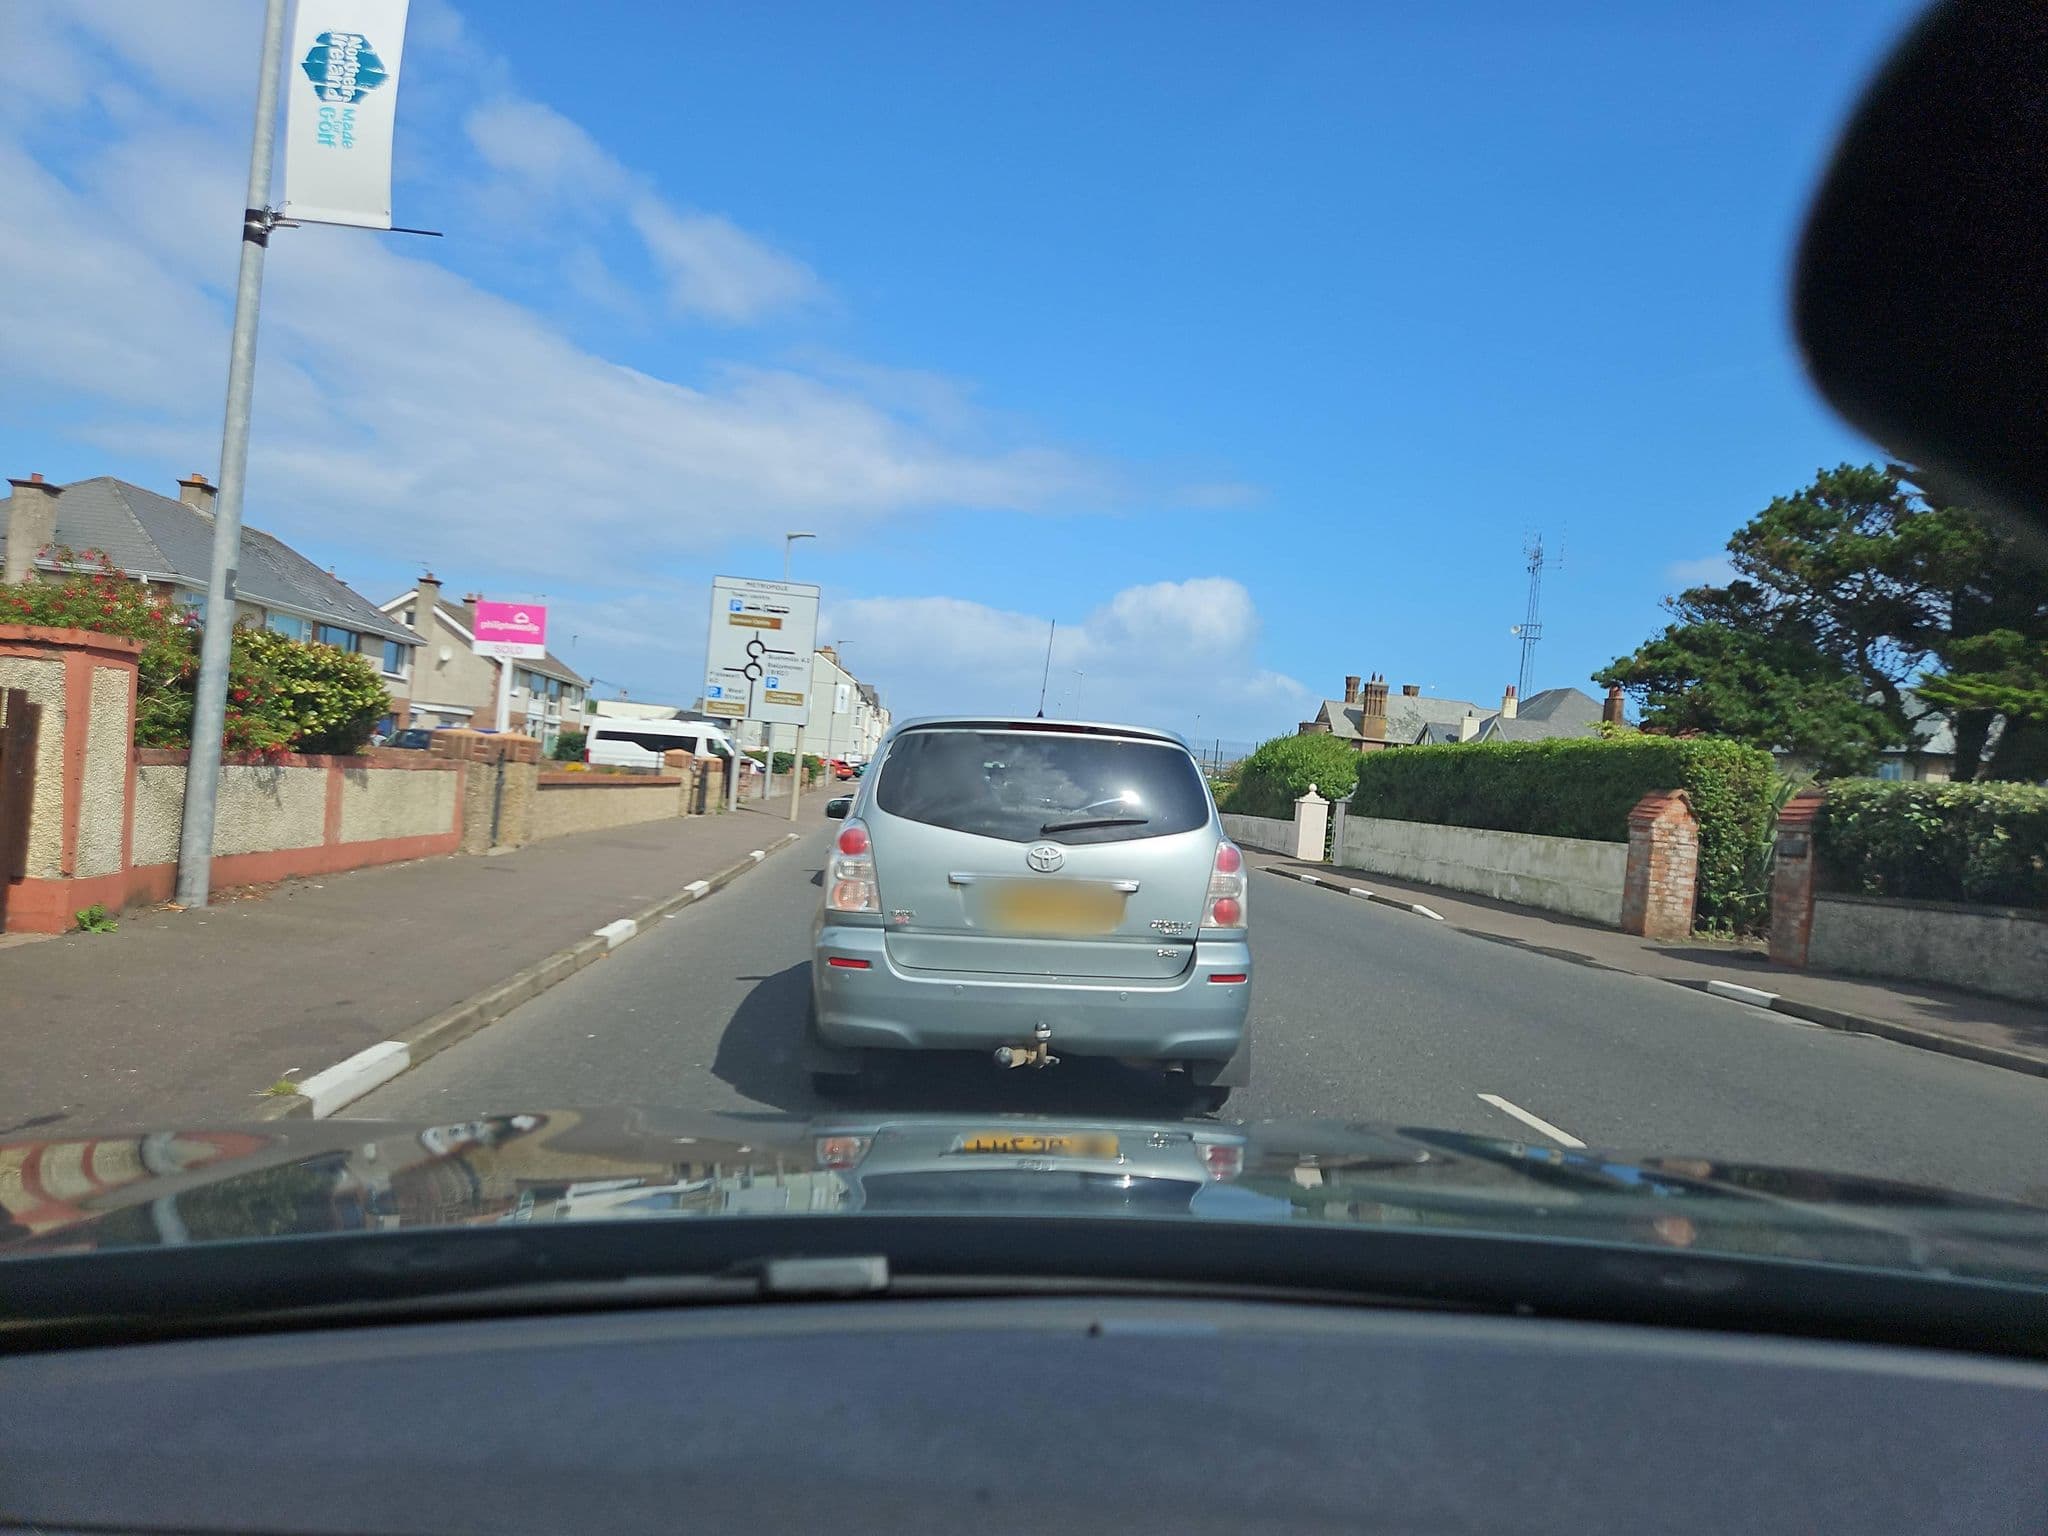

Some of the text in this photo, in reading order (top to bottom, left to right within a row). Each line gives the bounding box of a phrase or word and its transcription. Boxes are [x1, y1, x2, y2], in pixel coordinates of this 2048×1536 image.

[327, 35, 347, 102] Ireland
[342, 36, 362, 103] Northern
[318, 107, 336, 150] Golf
[333, 120, 342, 134] for
[341, 109, 355, 150] Made
